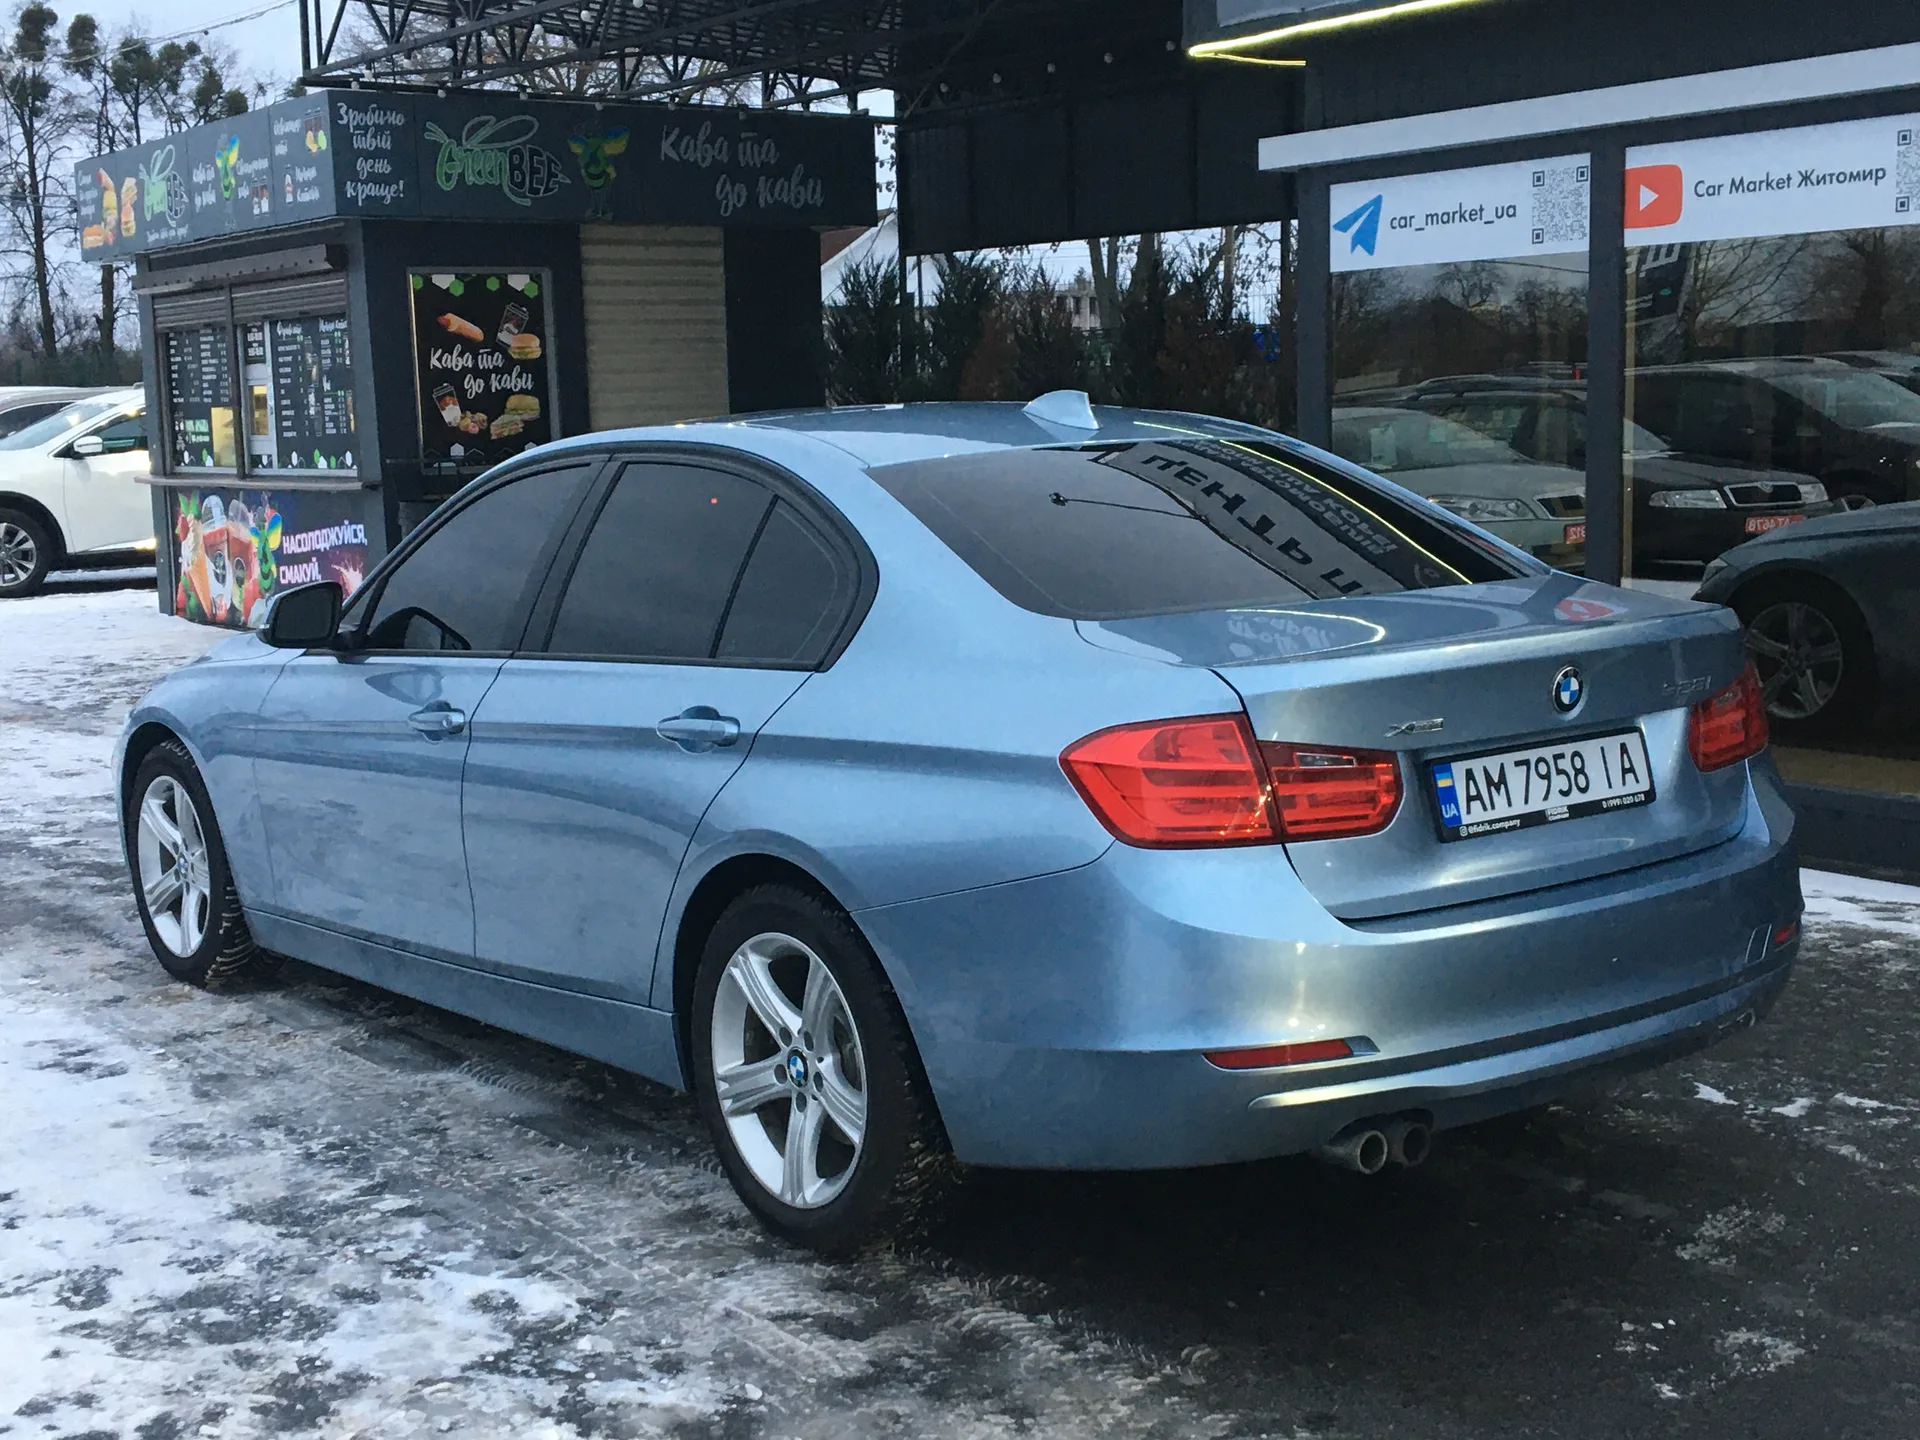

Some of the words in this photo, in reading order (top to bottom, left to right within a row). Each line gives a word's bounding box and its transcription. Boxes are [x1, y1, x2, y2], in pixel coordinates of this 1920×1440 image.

[337, 102, 404, 133] Зробимо
[353, 126, 392, 151] твій
[661, 120, 731, 168] Кава
[737, 132, 780, 167] та
[356, 157, 392, 180] день
[1693, 179, 1724, 197] Car
[1729, 172, 1792, 194] Market
[1797, 167, 1887, 188] Житомир
[345, 180, 404, 206] краще!
[715, 173, 748, 217] до
[756, 163, 825, 209] кави
[1390, 202, 1517, 231] car_market_ua
[430, 344, 475, 371] Кава
[477, 348, 505, 370] та
[464, 373, 485, 399] до
[489, 365, 534, 393] кави
[282, 519, 368, 554] НАСОЛОДЖУЙСЯ,
[279, 556, 322, 585] СМАКУЙ,
[1441, 804, 1459, 819] UA
